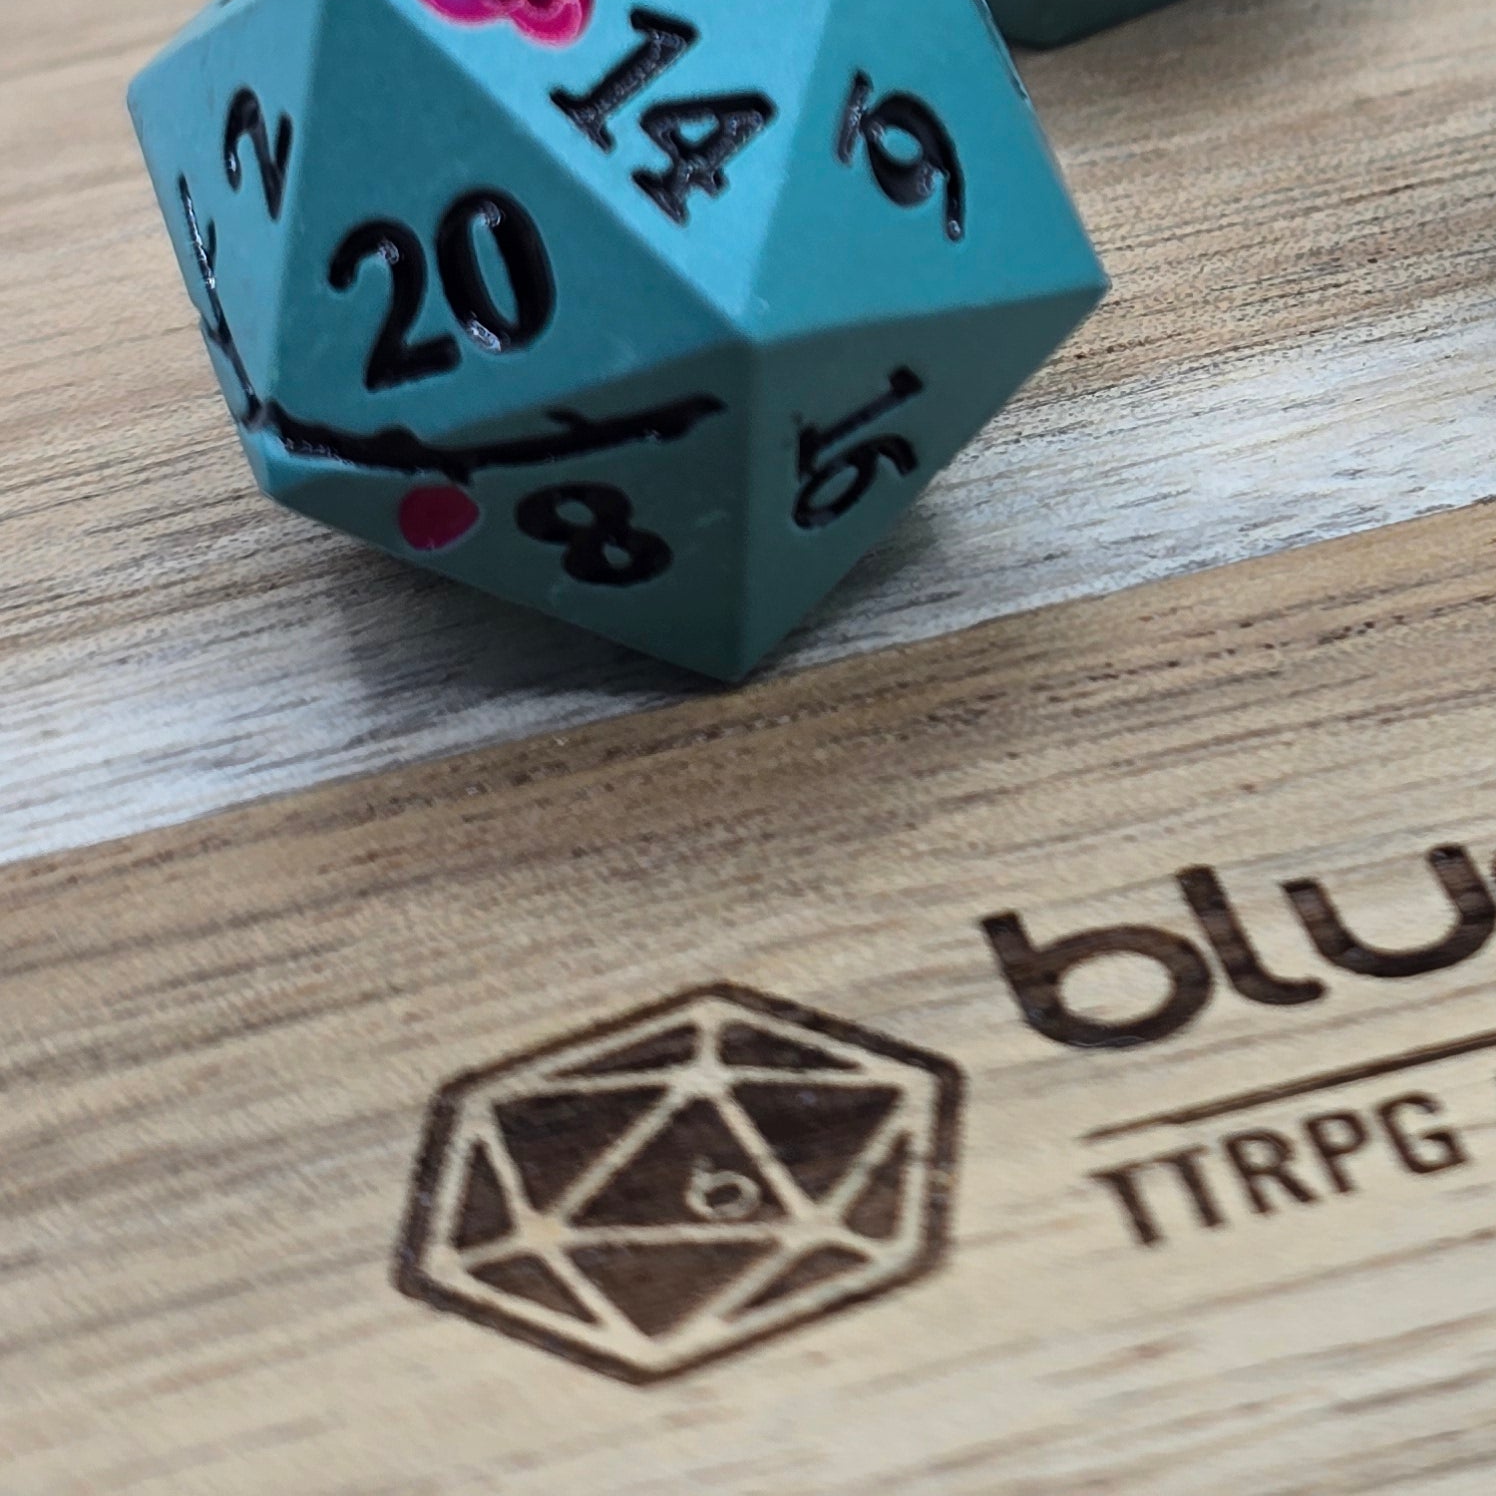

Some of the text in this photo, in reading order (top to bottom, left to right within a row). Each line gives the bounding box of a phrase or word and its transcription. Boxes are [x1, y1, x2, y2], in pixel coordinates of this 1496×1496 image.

[221, 85, 293, 222] 2
[549, 5, 778, 229] 14
[327, 187, 557, 393] 20
[514, 481, 675, 589] 8
[1090, 1090, 1468, 1247] TTRPG
